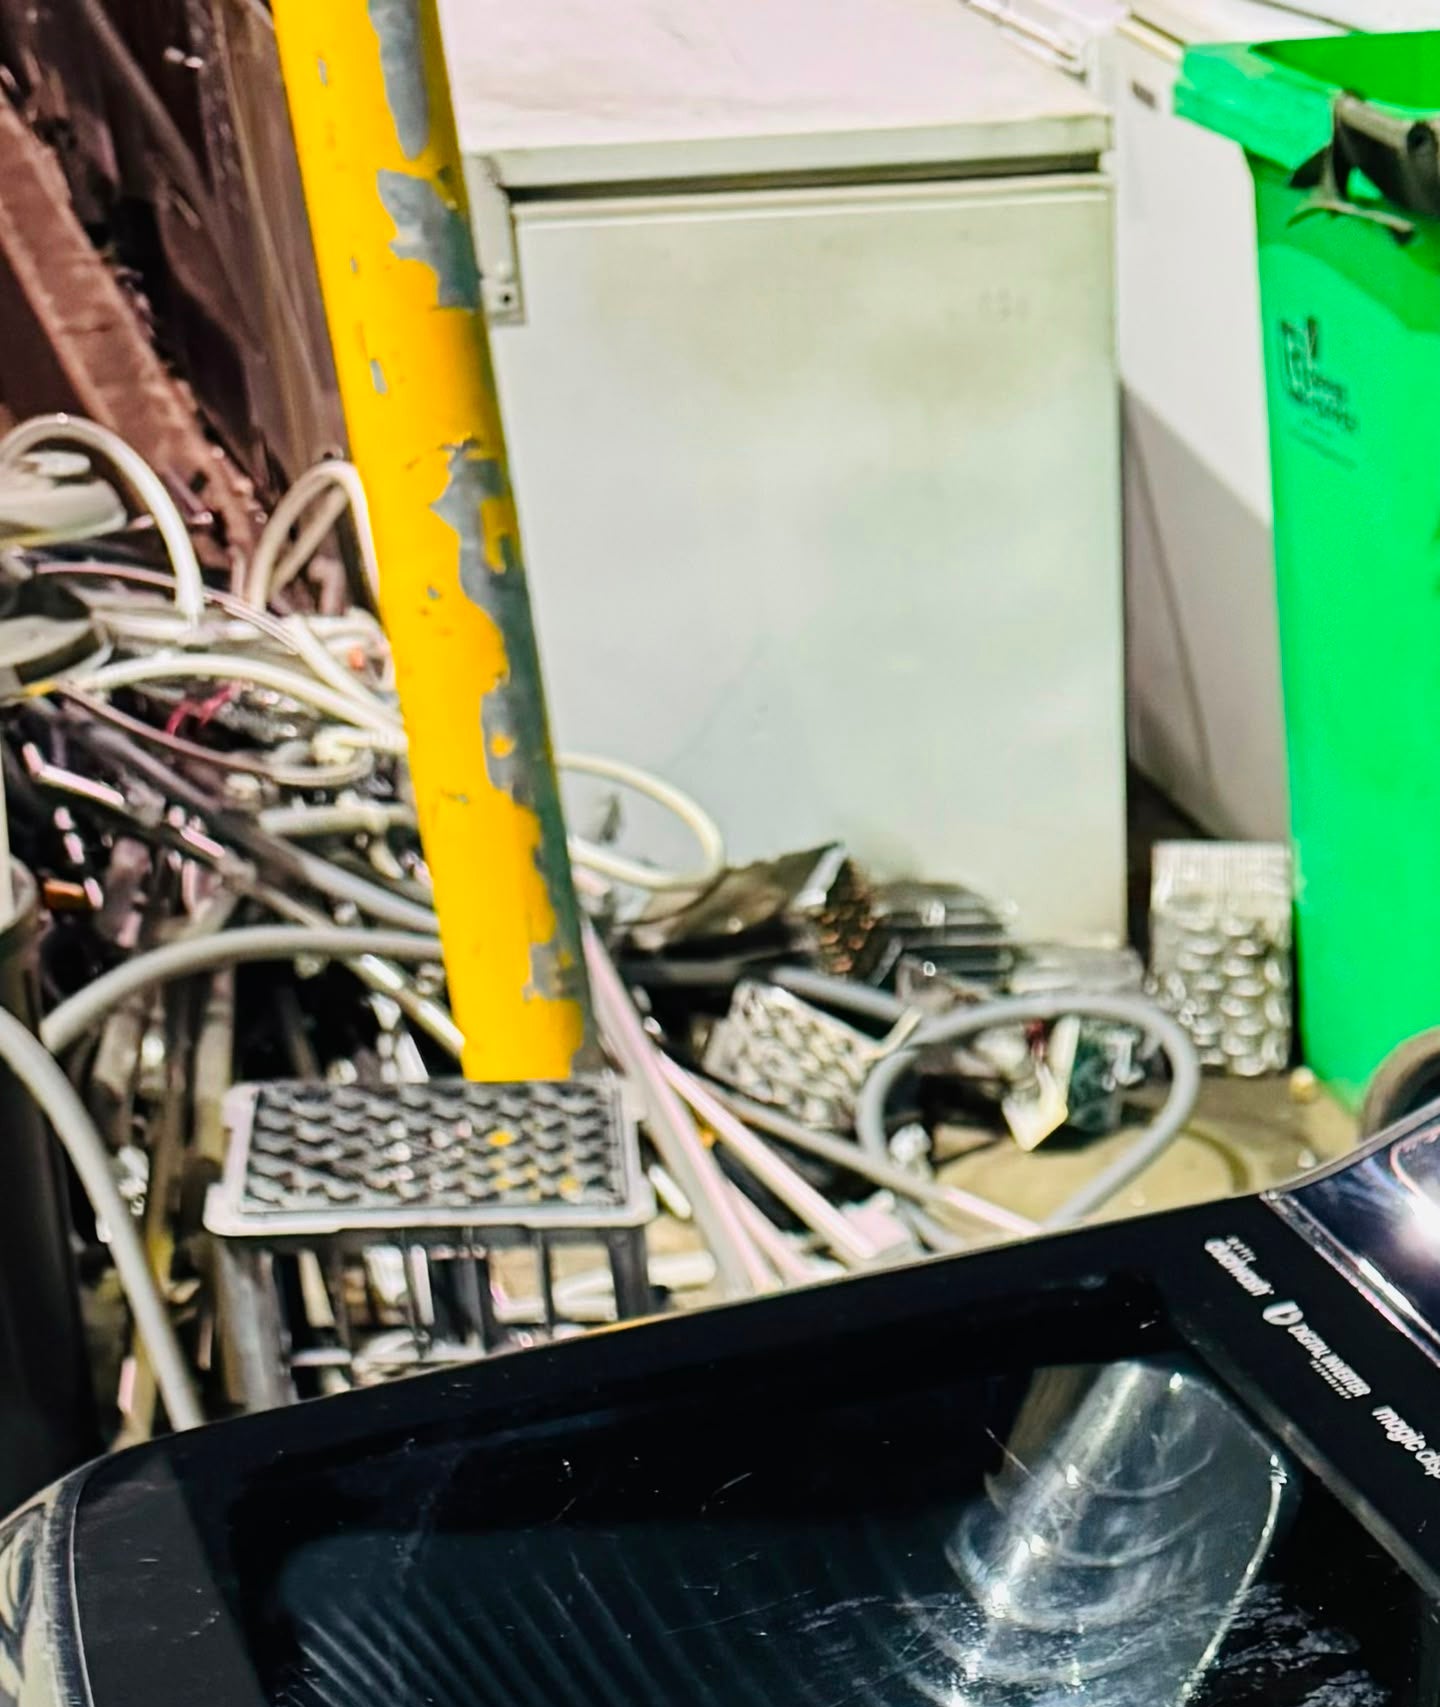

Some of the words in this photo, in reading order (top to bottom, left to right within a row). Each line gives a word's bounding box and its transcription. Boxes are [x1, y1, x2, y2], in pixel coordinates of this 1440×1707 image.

[1288, 1322, 1331, 1359] DIGITAL
[1320, 1353, 1371, 1397] INVERTER
[1372, 1405, 1426, 1451] magic
